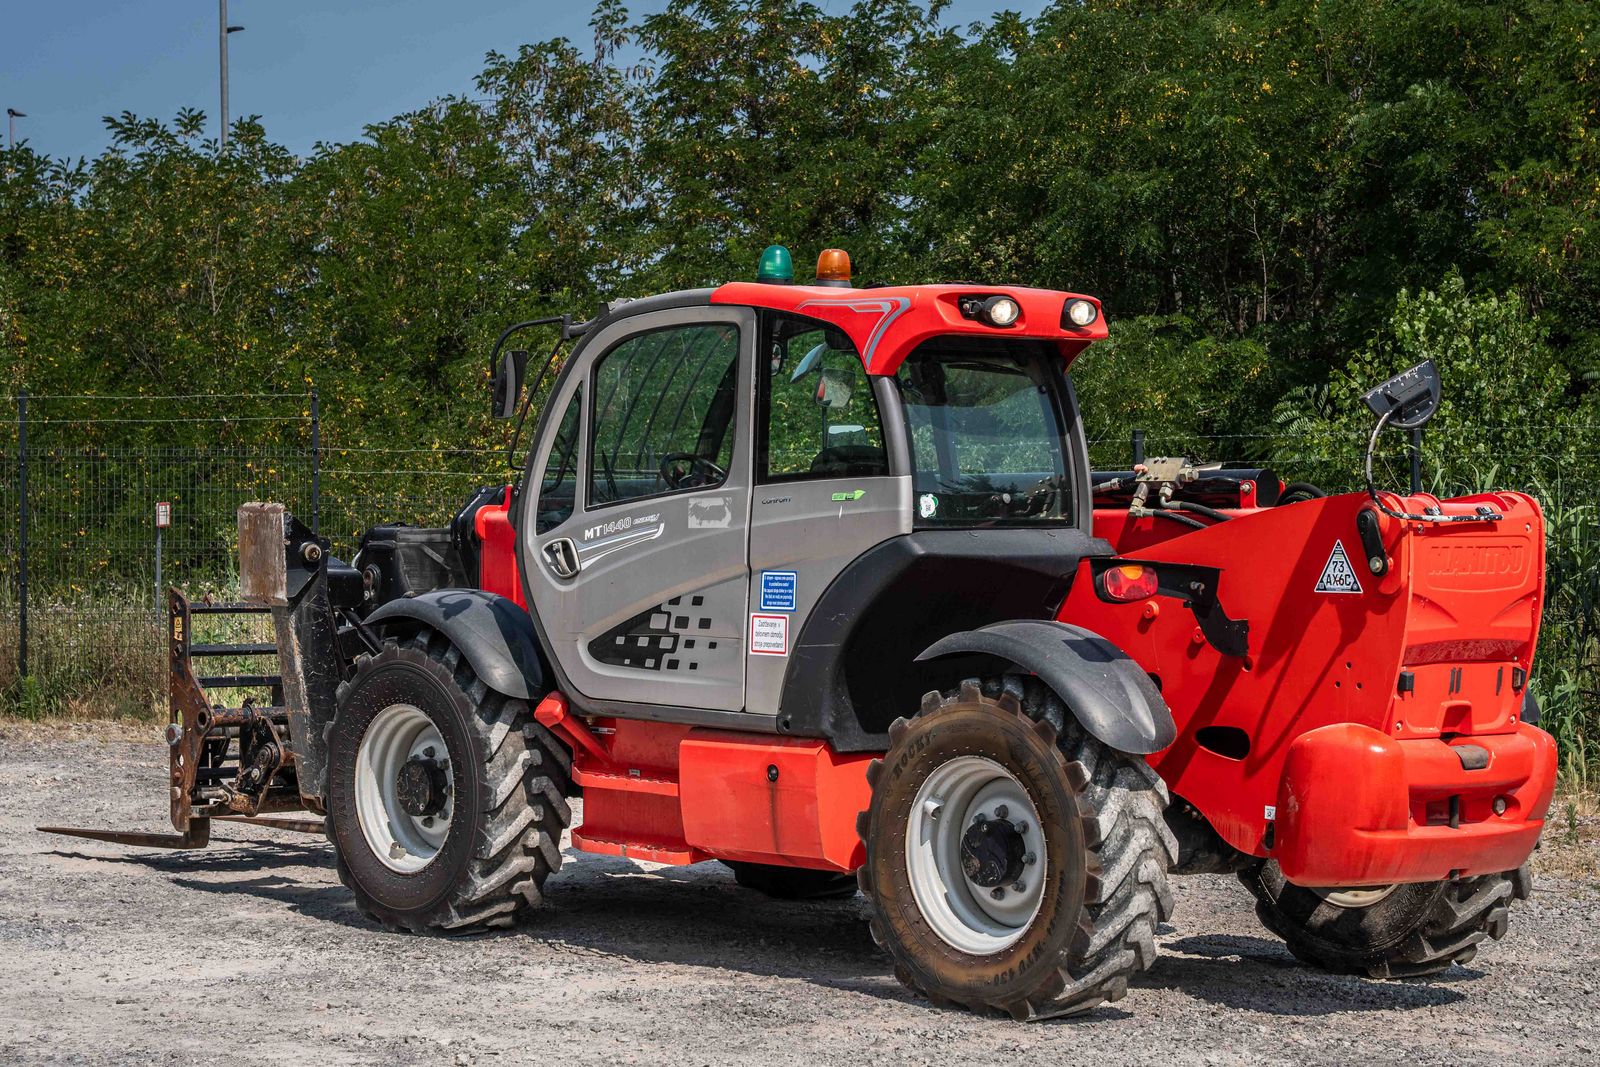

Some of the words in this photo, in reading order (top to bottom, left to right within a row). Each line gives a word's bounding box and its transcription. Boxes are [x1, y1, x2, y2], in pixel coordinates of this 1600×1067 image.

[1332, 560, 1345, 573] 73
[1428, 545, 1524, 576] MANITOU
[892, 732, 931, 781] ROCKY
